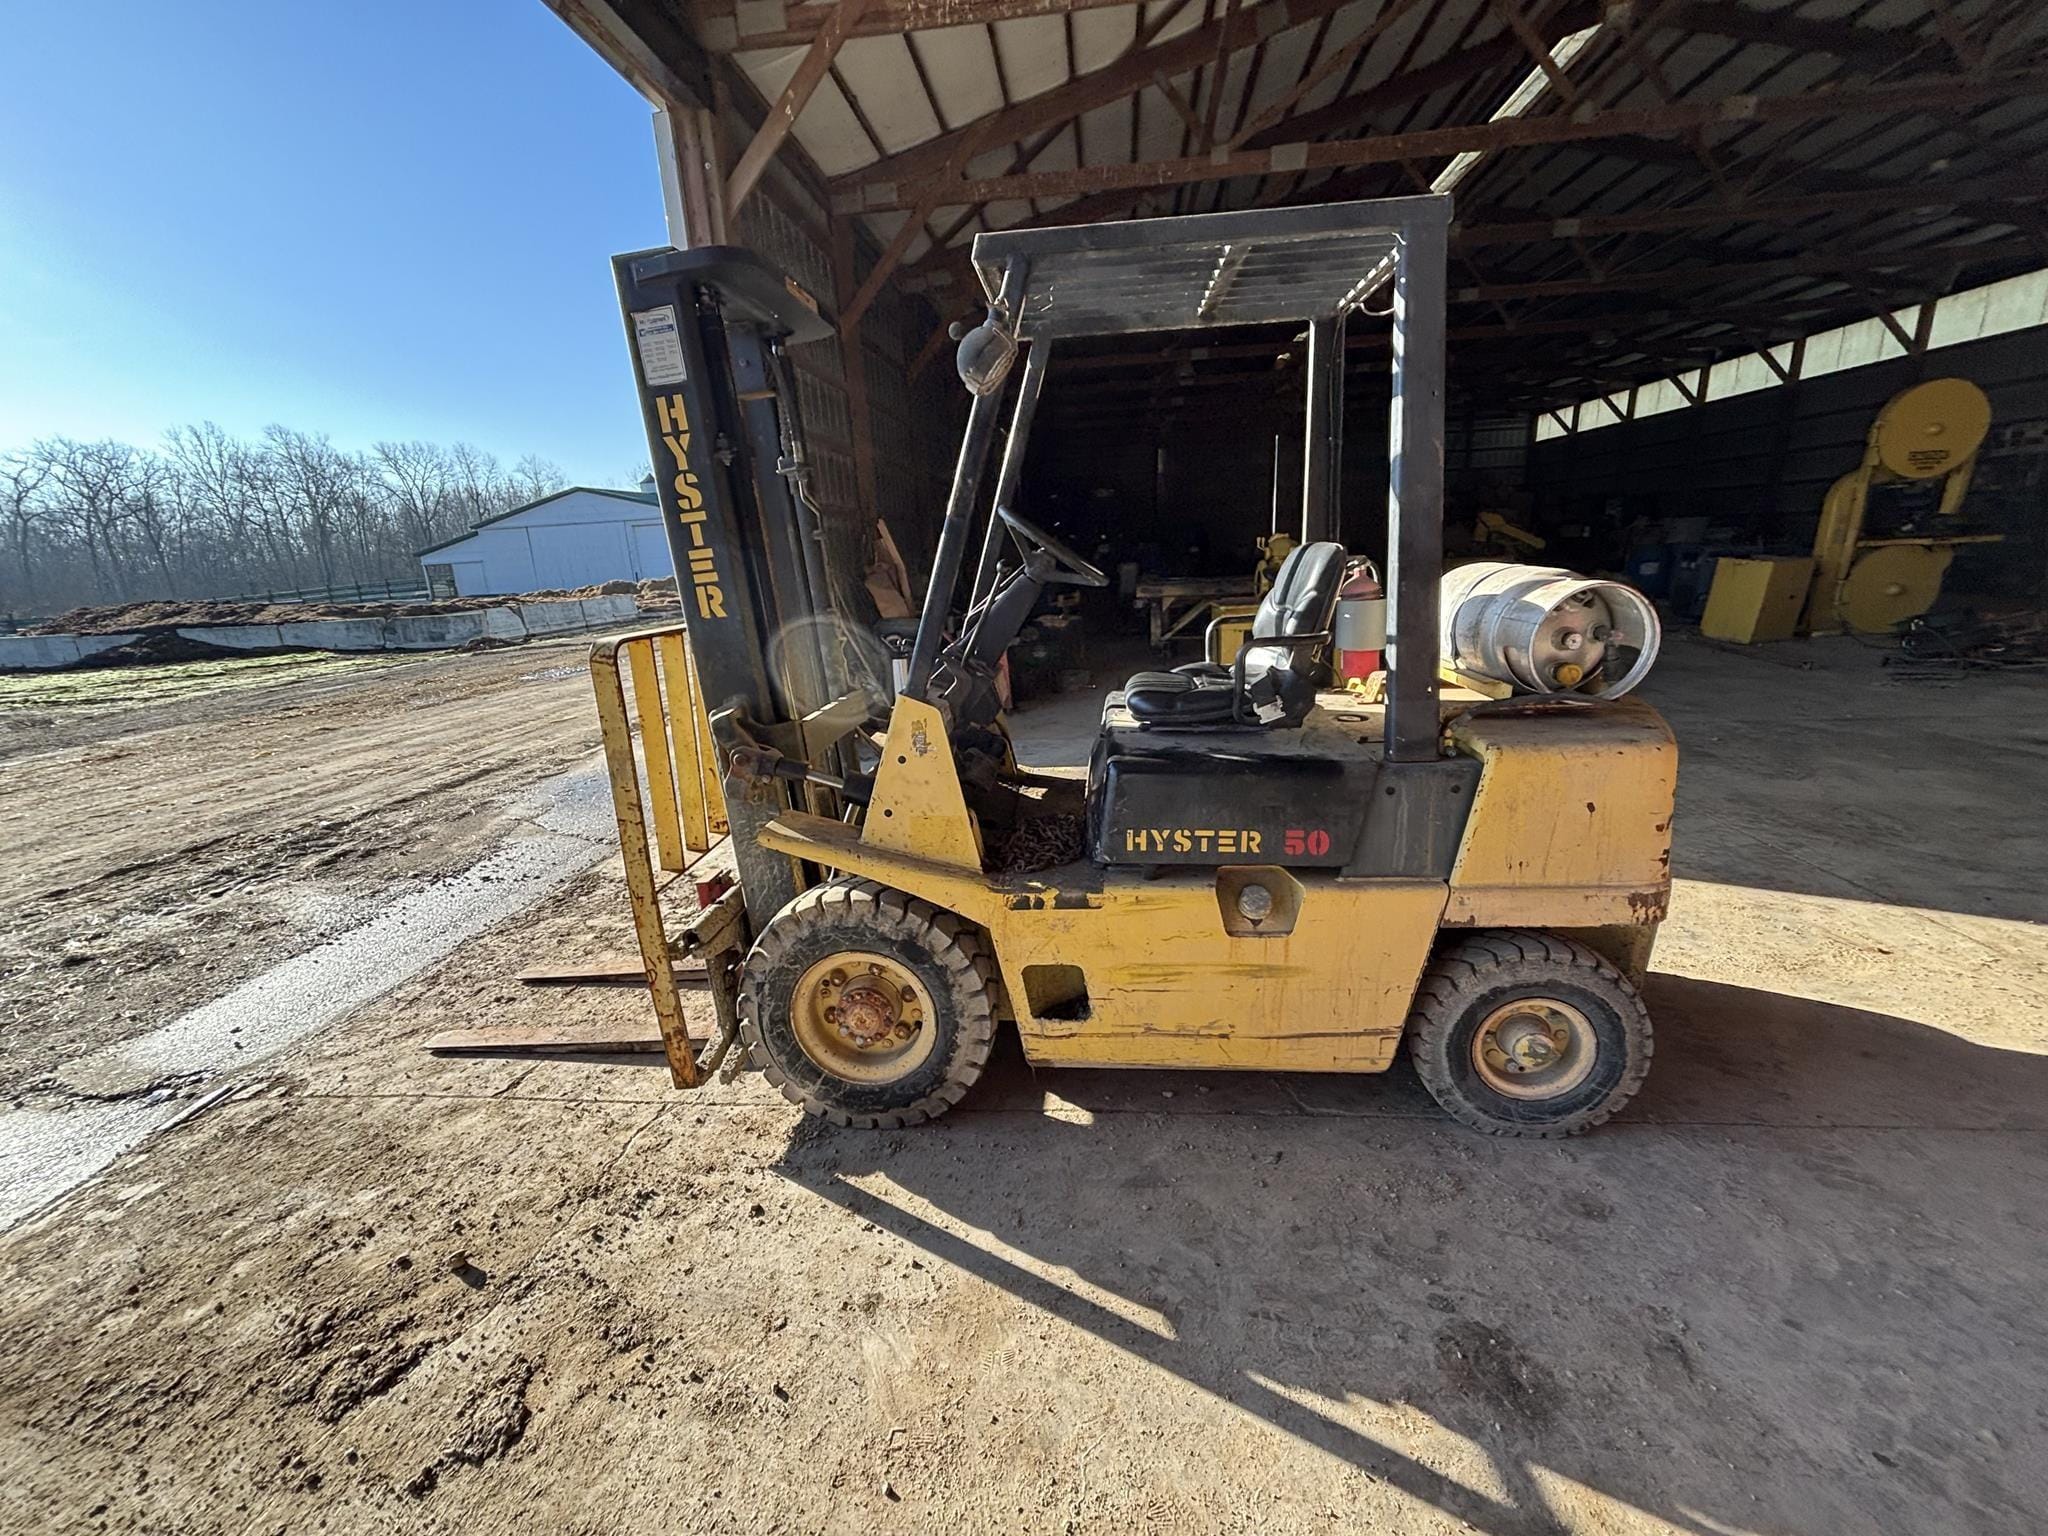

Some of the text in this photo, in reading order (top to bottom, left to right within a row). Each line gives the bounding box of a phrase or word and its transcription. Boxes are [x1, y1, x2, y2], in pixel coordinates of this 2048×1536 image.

[655, 393, 728, 619] HYSTER
[1126, 829, 1331, 856] HYSTER 50
